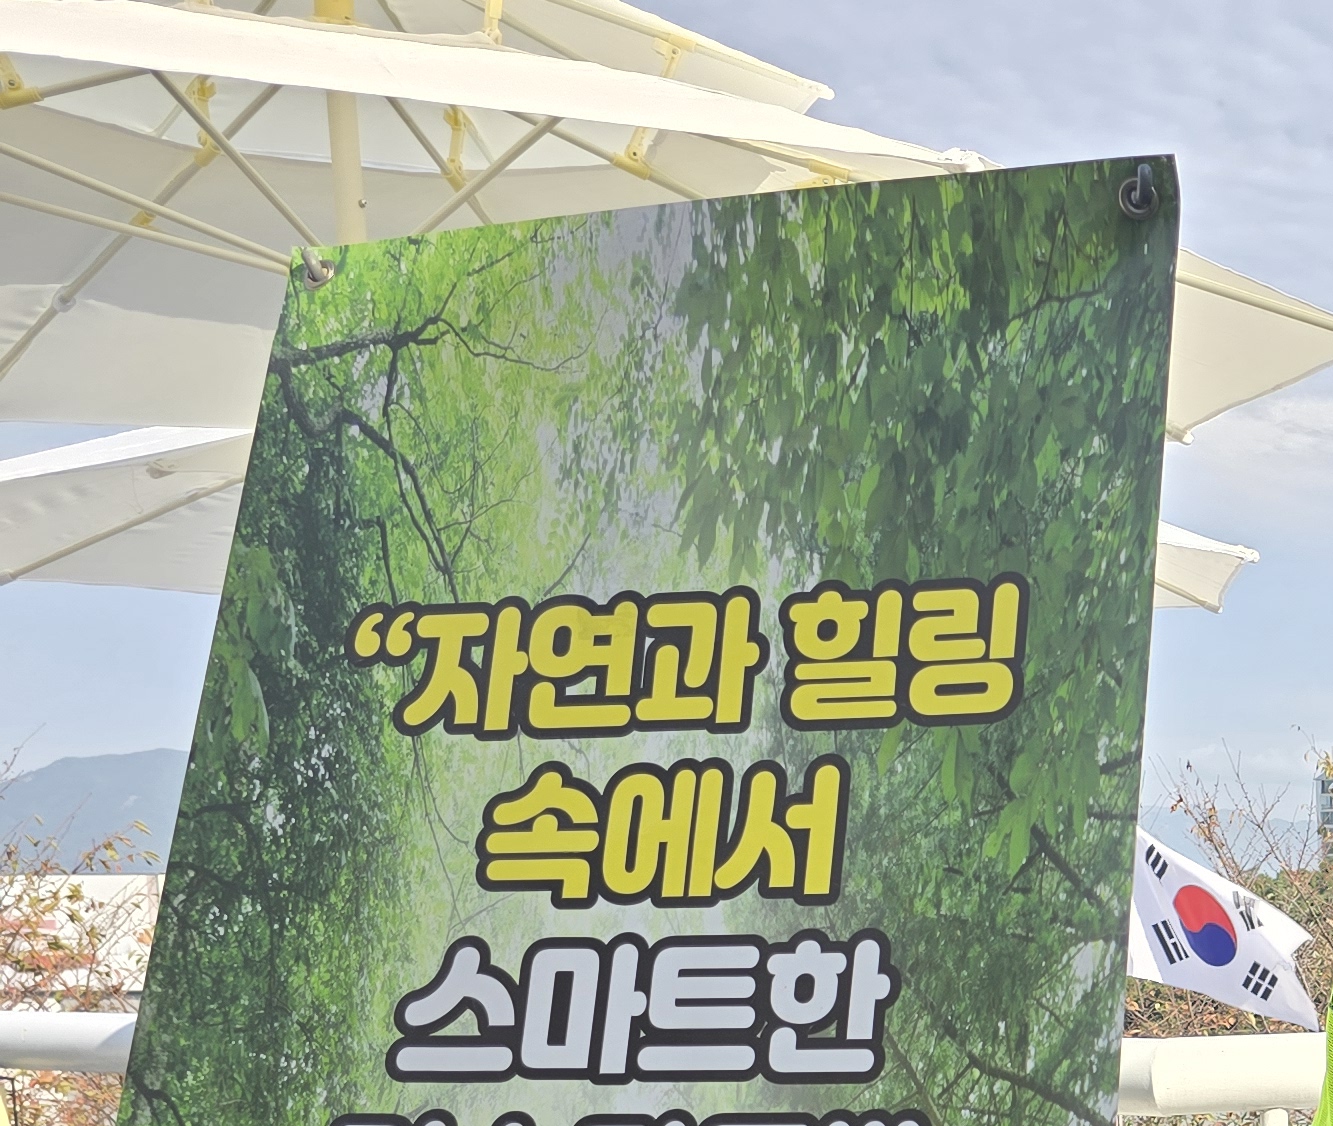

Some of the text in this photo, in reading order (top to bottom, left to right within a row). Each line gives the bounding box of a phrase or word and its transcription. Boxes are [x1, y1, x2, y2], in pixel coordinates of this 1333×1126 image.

[348, 575, 1024, 737] “자연과 힐링
[480, 760, 846, 904] 속에서
[394, 934, 895, 1080] 스마트한
